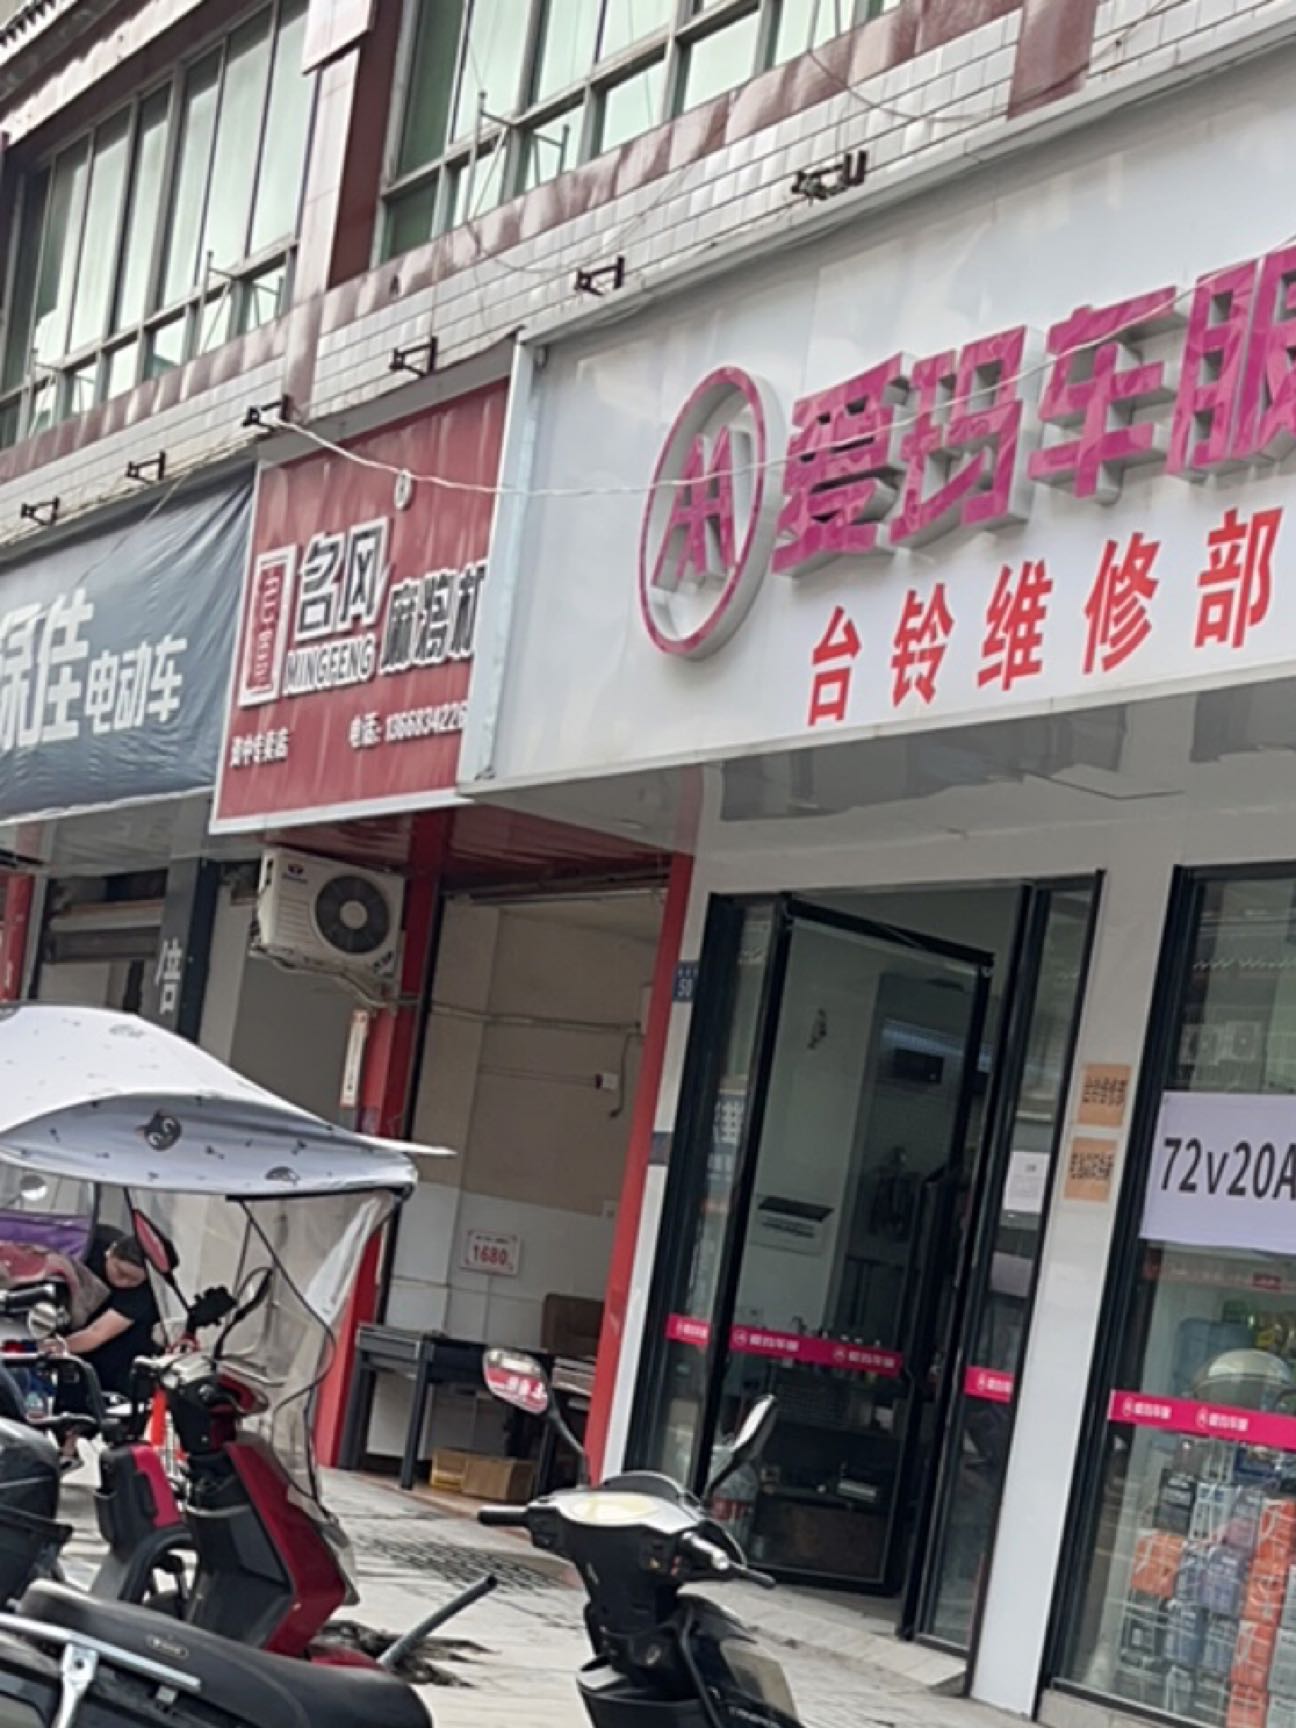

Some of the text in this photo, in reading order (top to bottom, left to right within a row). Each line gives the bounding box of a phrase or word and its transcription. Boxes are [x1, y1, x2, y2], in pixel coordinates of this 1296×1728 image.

[296, 517, 392, 641] 名风
[807, 506, 1284, 726] 台铃维修部
[85, 633, 188, 735] 电动车
